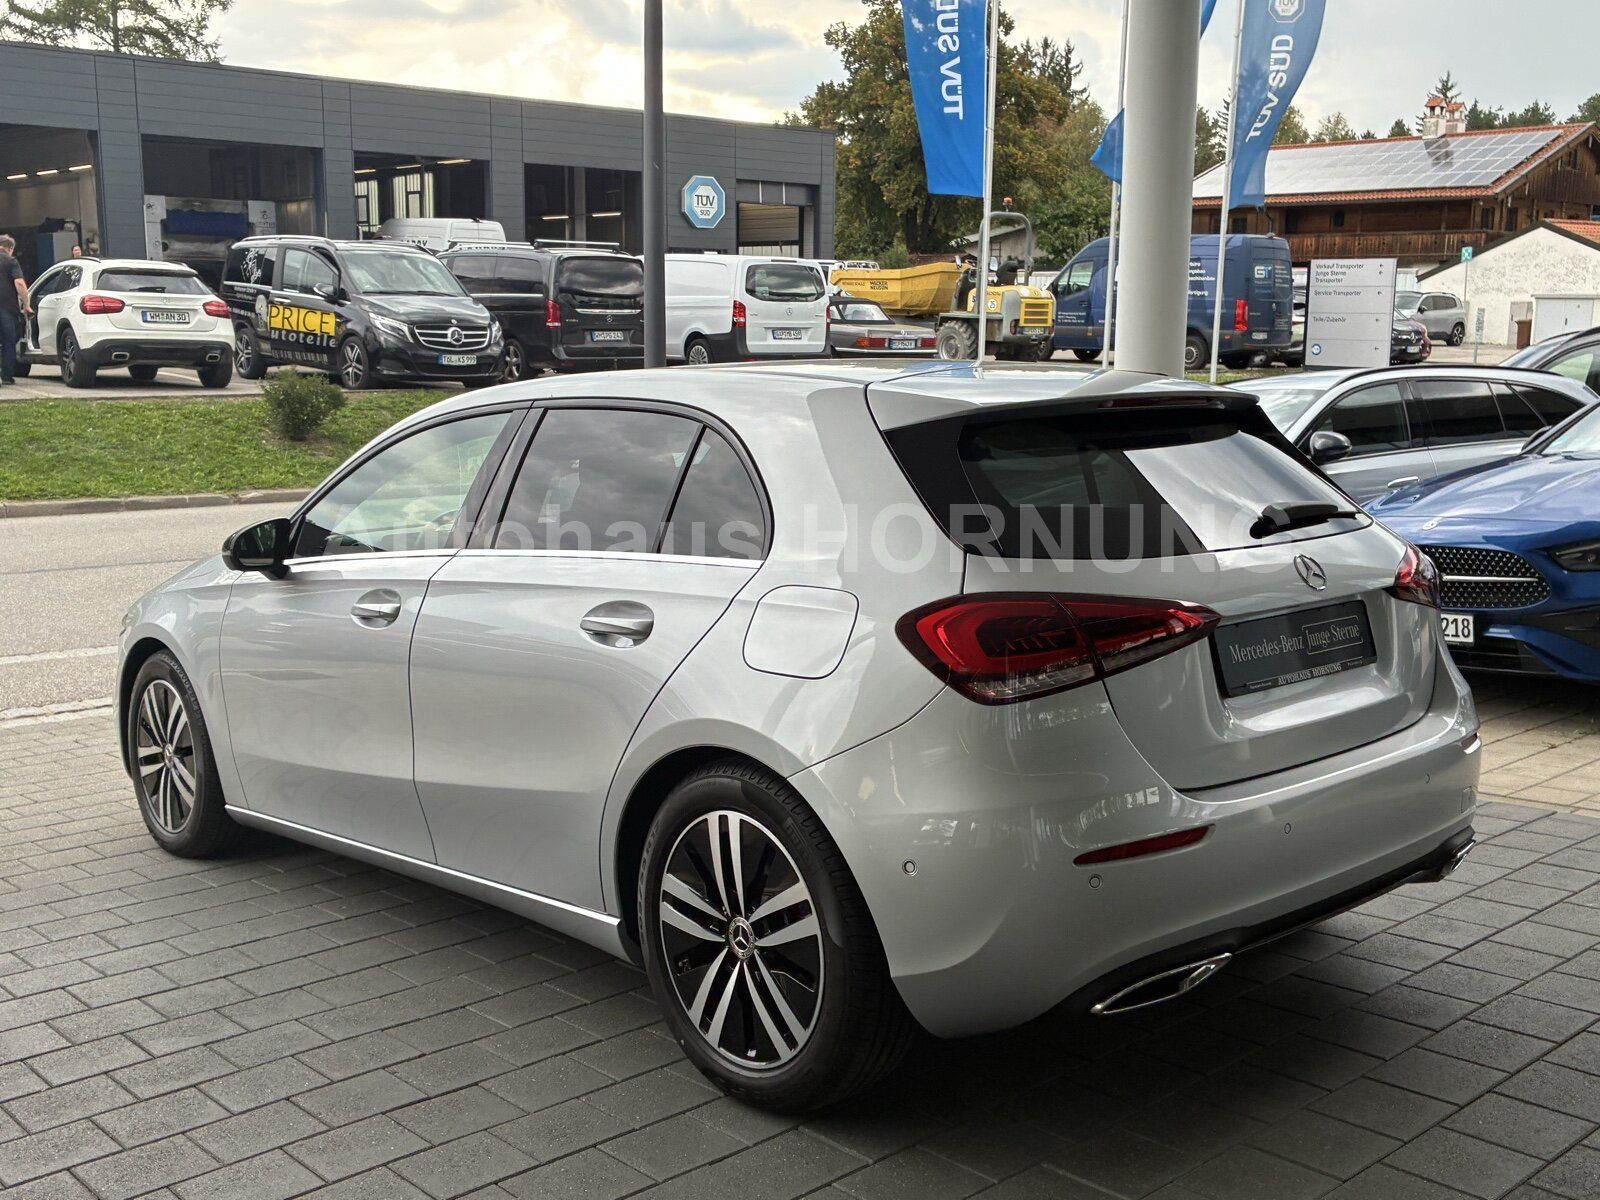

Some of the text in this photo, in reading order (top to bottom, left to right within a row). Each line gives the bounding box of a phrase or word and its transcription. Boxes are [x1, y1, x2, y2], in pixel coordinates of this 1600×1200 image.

[1245, 34, 1294, 143] TÜV SÜD
[695, 194, 715, 207] TÜV
[269, 305, 331, 335] PRICE
[1441, 617, 1471, 638] 218
[1229, 624, 1360, 664] Mercedes-Benz Junge Sterne
[1278, 671, 1312, 685] AUTOHAUS
[1313, 663, 1342, 677] HORNUNG
